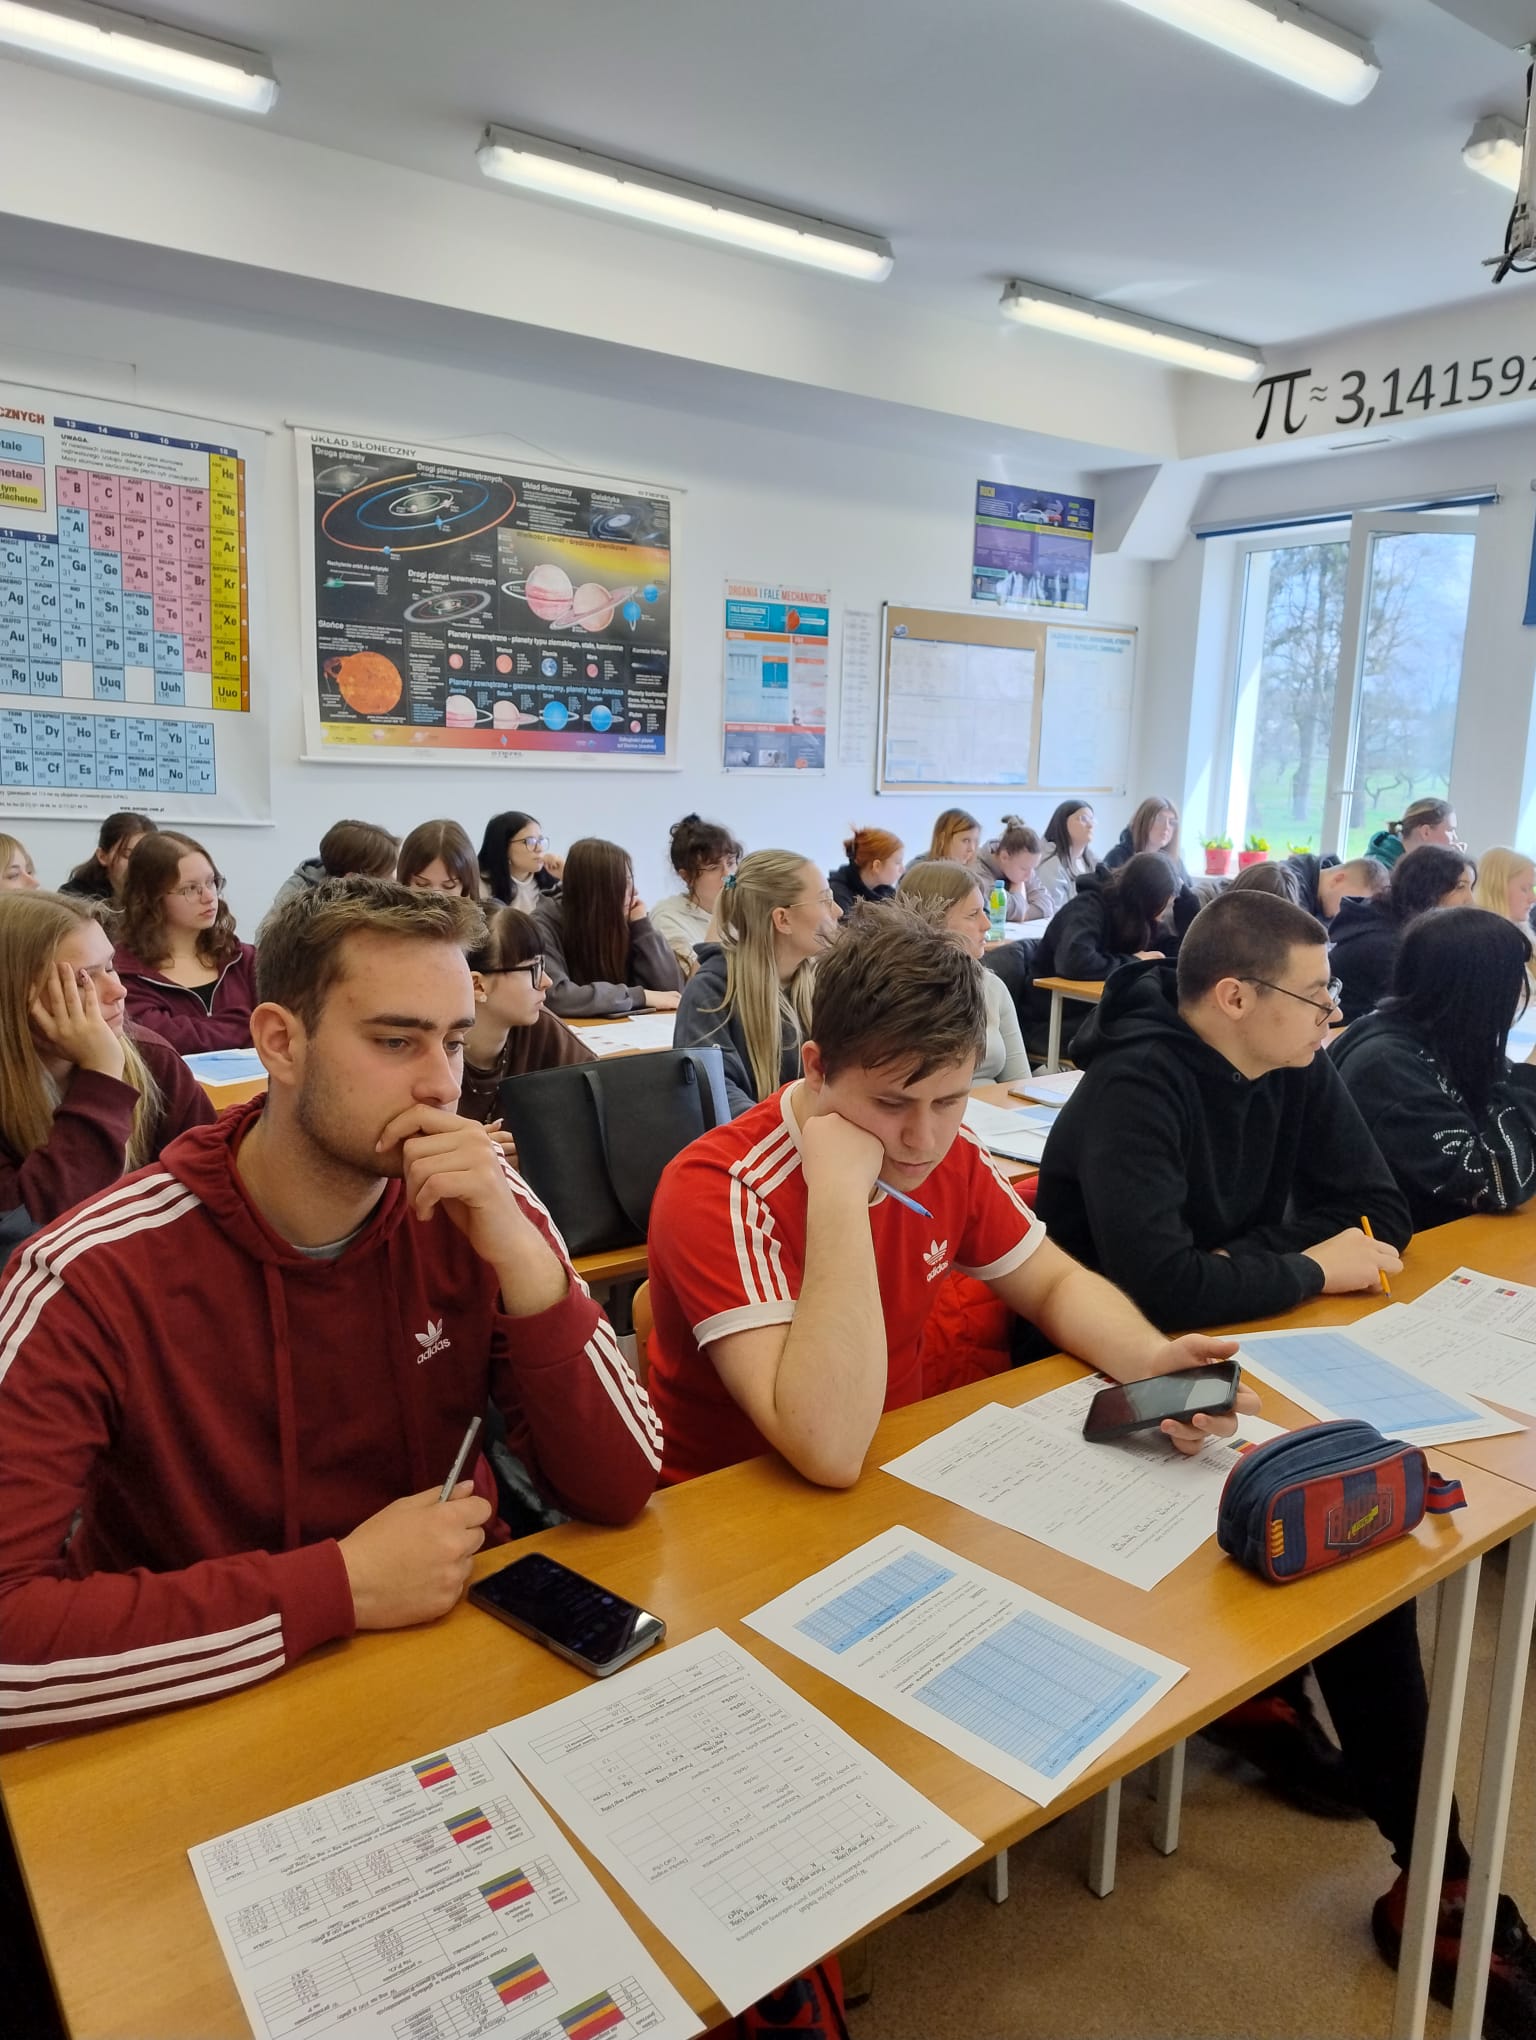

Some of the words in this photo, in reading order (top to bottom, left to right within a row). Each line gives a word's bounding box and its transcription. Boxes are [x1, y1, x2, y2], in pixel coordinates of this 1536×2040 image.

[66, 420, 76, 428] 13
[98, 426, 108, 434] 14
[0, 441, 22, 451] tale
[160, 437, 169, 445] 16
[311, 434, 348, 448] UKŁAD
[351, 441, 417, 457] SŁONECZNY
[219, 447, 229, 455] 18
[222, 468, 234, 480] He
[74, 482, 81, 493] B
[105, 488, 112, 498] C
[136, 492, 144, 502] N
[166, 497, 173, 507] O
[196, 501, 202, 511] F
[222, 505, 235, 516] Ne
[73, 521, 84, 532] Al
[105, 526, 115, 537] Si
[137, 530, 144, 540] P
[167, 534, 173, 545] S
[194, 538, 205, 549] Cl
[223, 542, 235, 552] Ar
[7, 552, 22, 563] Cu
[40, 556, 54, 567] Zn
[72, 560, 86, 571] Ga
[103, 564, 118, 575] Ge
[135, 568, 149, 579] As
[165, 571, 177, 582] Se
[194, 575, 206, 586] Br
[224, 579, 236, 589] Kr
[8, 592, 24, 605] Ag
[764, 588, 780, 600] FALE
[41, 595, 56, 606] Cd
[75, 598, 86, 609] In
[105, 602, 119, 613] Sn
[136, 605, 149, 616] Sb
[166, 608, 177, 620] Te
[199, 612, 202, 622] I
[223, 615, 236, 626] Xe
[9, 630, 25, 642] Au
[42, 633, 57, 647] Hg
[76, 637, 86, 648] Tl
[106, 639, 119, 650] Pb
[138, 642, 148, 653] Bi
[167, 645, 180, 656] Po
[195, 648, 207, 659] At
[224, 651, 237, 662] Rn
[12, 669, 26, 682] Rg
[36, 671, 58, 683] Uub
[100, 676, 121, 690] Uuq
[160, 681, 181, 693] Uuh
[218, 686, 238, 698] Uuo
[13, 723, 27, 734] Tb
[45, 725, 60, 738] Dy
[77, 727, 91, 738] Ho
[110, 729, 120, 739] Er
[137, 731, 153, 742] Tm
[169, 733, 182, 744] Yb
[199, 735, 209, 745] Lu
[15, 761, 29, 772] Bk
[47, 762, 60, 773] Cf
[80, 764, 91, 775] Es
[108, 766, 124, 776] Fm
[138, 767, 154, 778] Md
[169, 769, 183, 779] No
[201, 771, 210, 780] Lr
[927, 1260, 948, 1282] adidas
[417, 1338, 451, 1364] adidas
